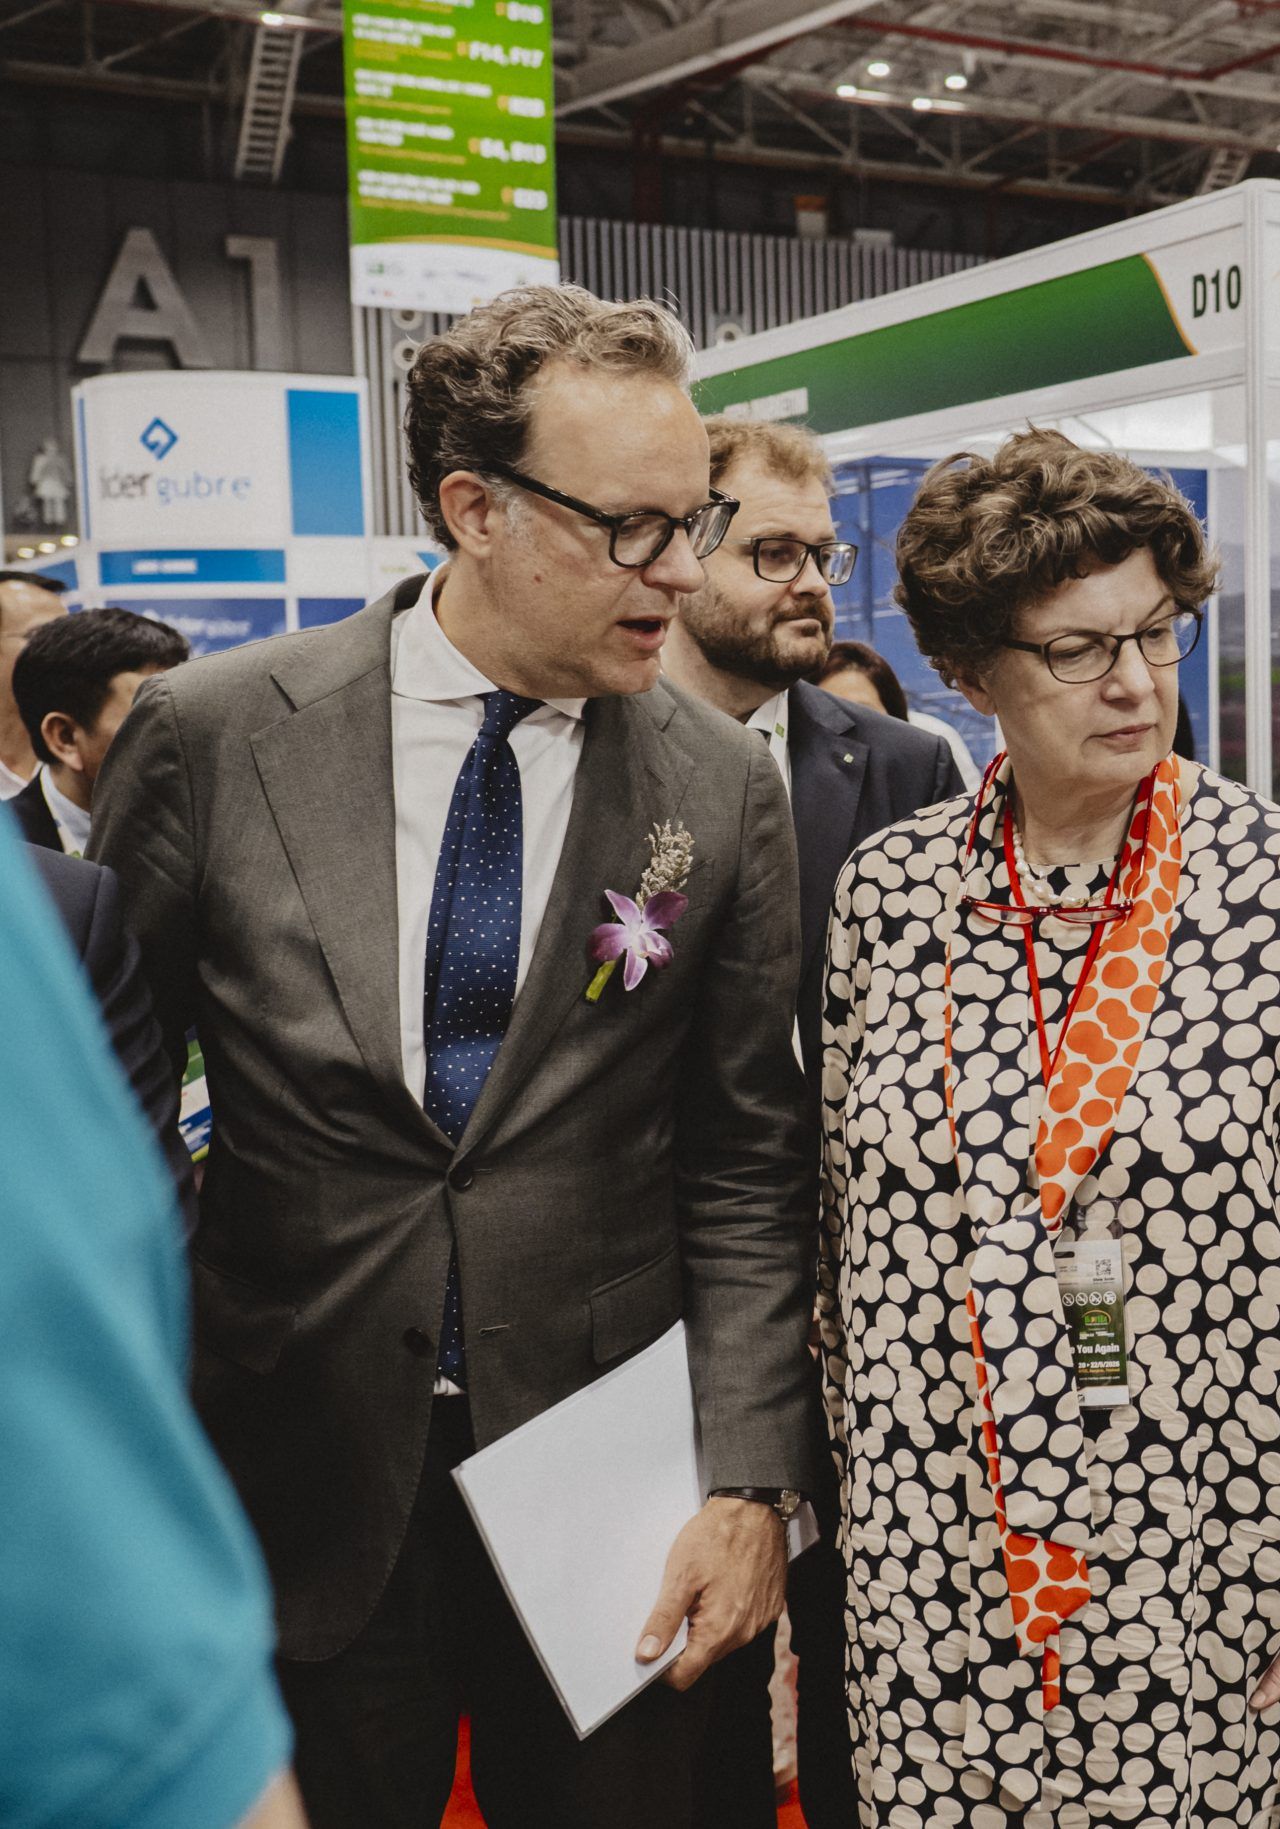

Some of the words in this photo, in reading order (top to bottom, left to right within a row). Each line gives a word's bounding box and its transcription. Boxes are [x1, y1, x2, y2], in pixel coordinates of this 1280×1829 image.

[77, 226, 282, 370] A1
[1193, 264, 1241, 319] D10
[1076, 1344, 1093, 1354] You
[1095, 1342, 1120, 1355] Again
